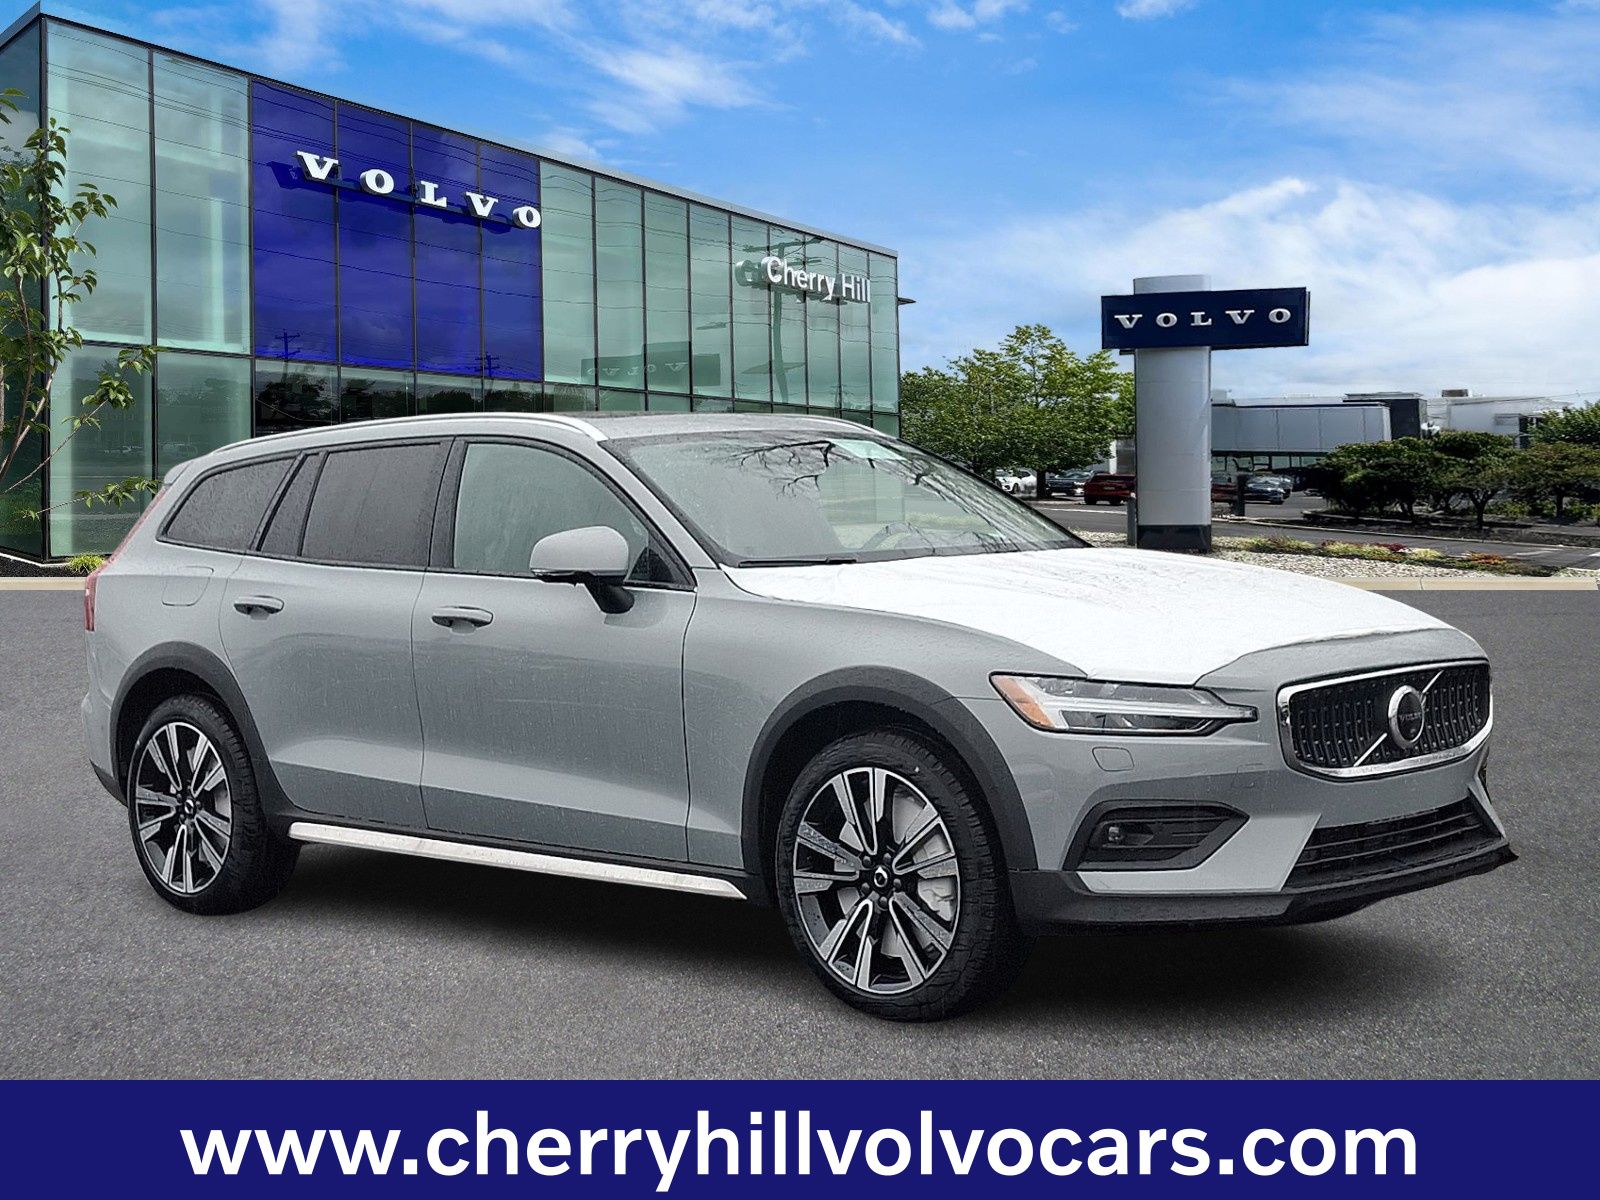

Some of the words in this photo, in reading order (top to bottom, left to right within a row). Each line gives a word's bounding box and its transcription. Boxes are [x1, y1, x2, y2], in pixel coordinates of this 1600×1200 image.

[296, 150, 542, 228] VOLVO
[763, 256, 836, 301] Cherry
[841, 273, 870, 302] Hill
[1114, 308, 1292, 329] VOLVO
